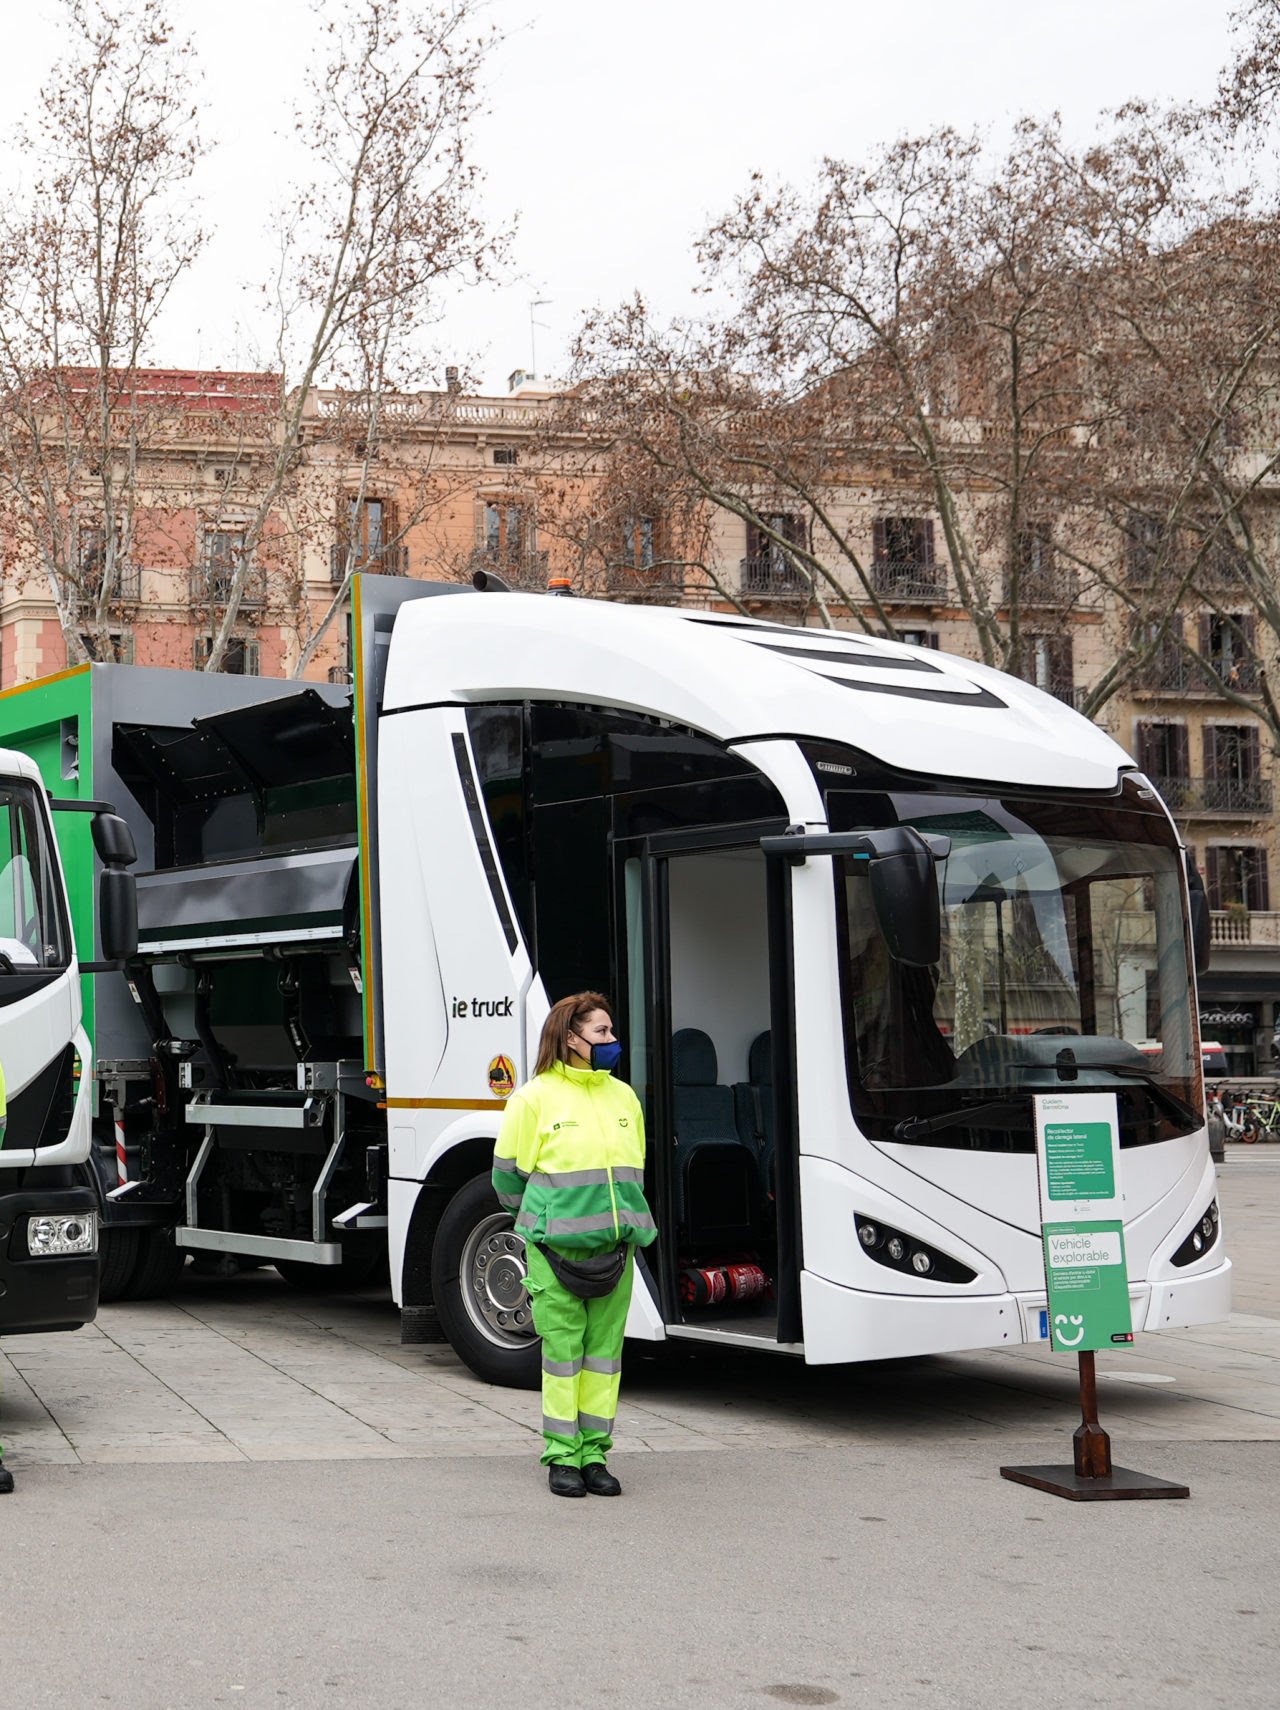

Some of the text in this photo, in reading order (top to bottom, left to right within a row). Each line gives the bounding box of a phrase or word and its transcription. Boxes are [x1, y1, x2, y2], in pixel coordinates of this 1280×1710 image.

[452, 996, 514, 1018] ie truck
[1051, 1239, 1091, 1250] Vehicle
[1052, 1249, 1110, 1264] explorable
